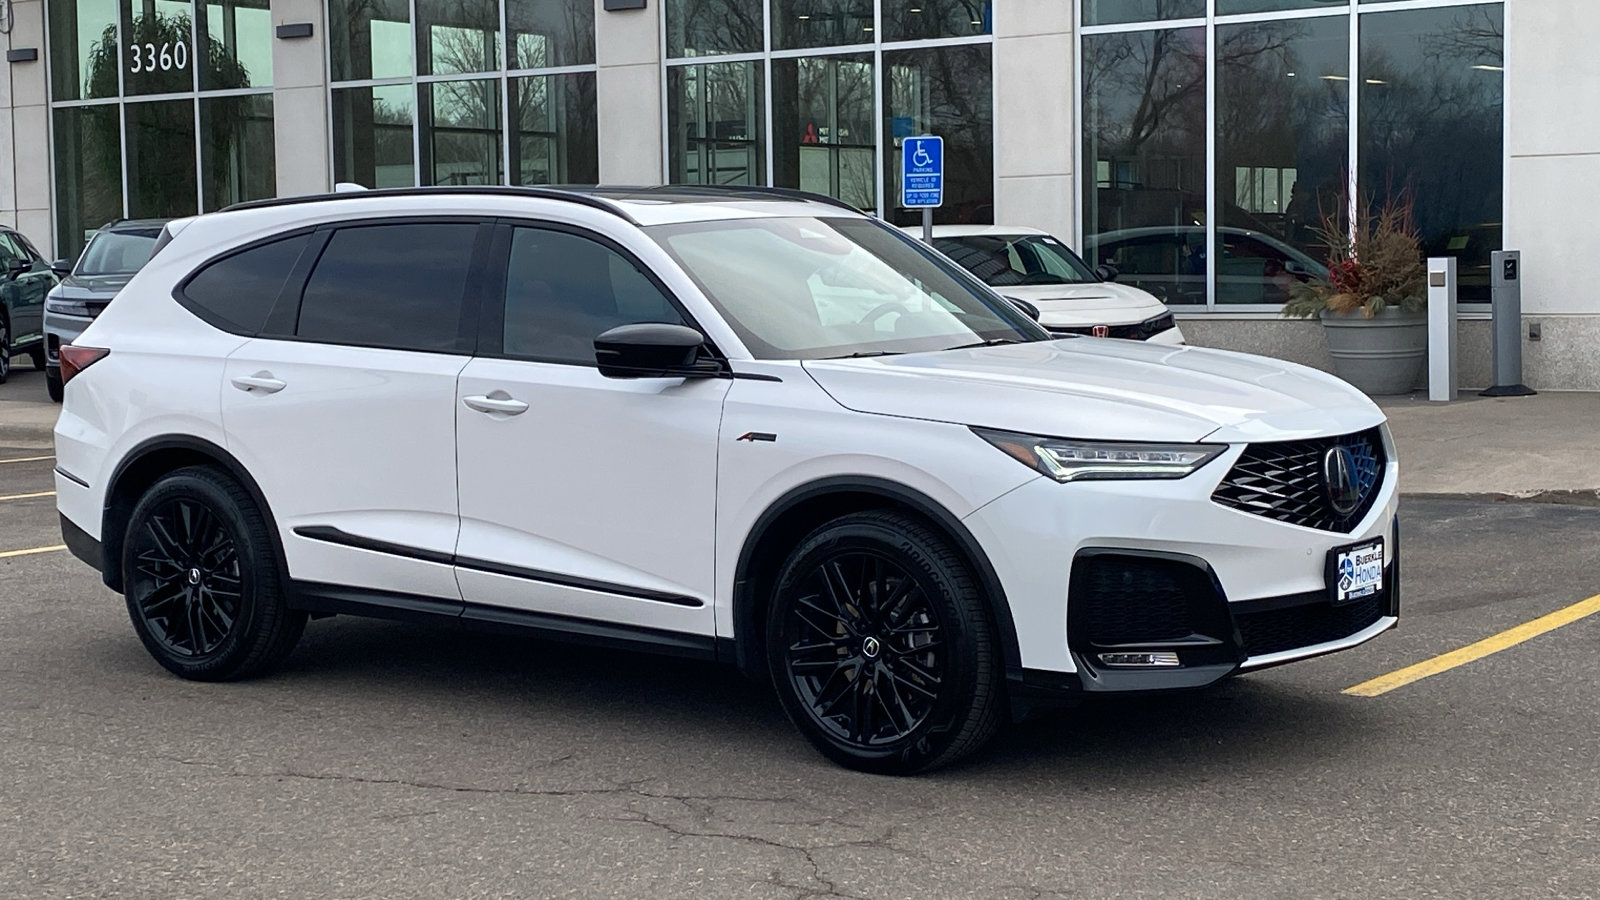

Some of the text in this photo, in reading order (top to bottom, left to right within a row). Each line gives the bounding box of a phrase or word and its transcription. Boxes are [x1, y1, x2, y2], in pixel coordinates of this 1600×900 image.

[130, 41, 187, 73] 3360
[1355, 551, 1382, 566] BUERKLE
[1355, 565, 1382, 585] HONDA
